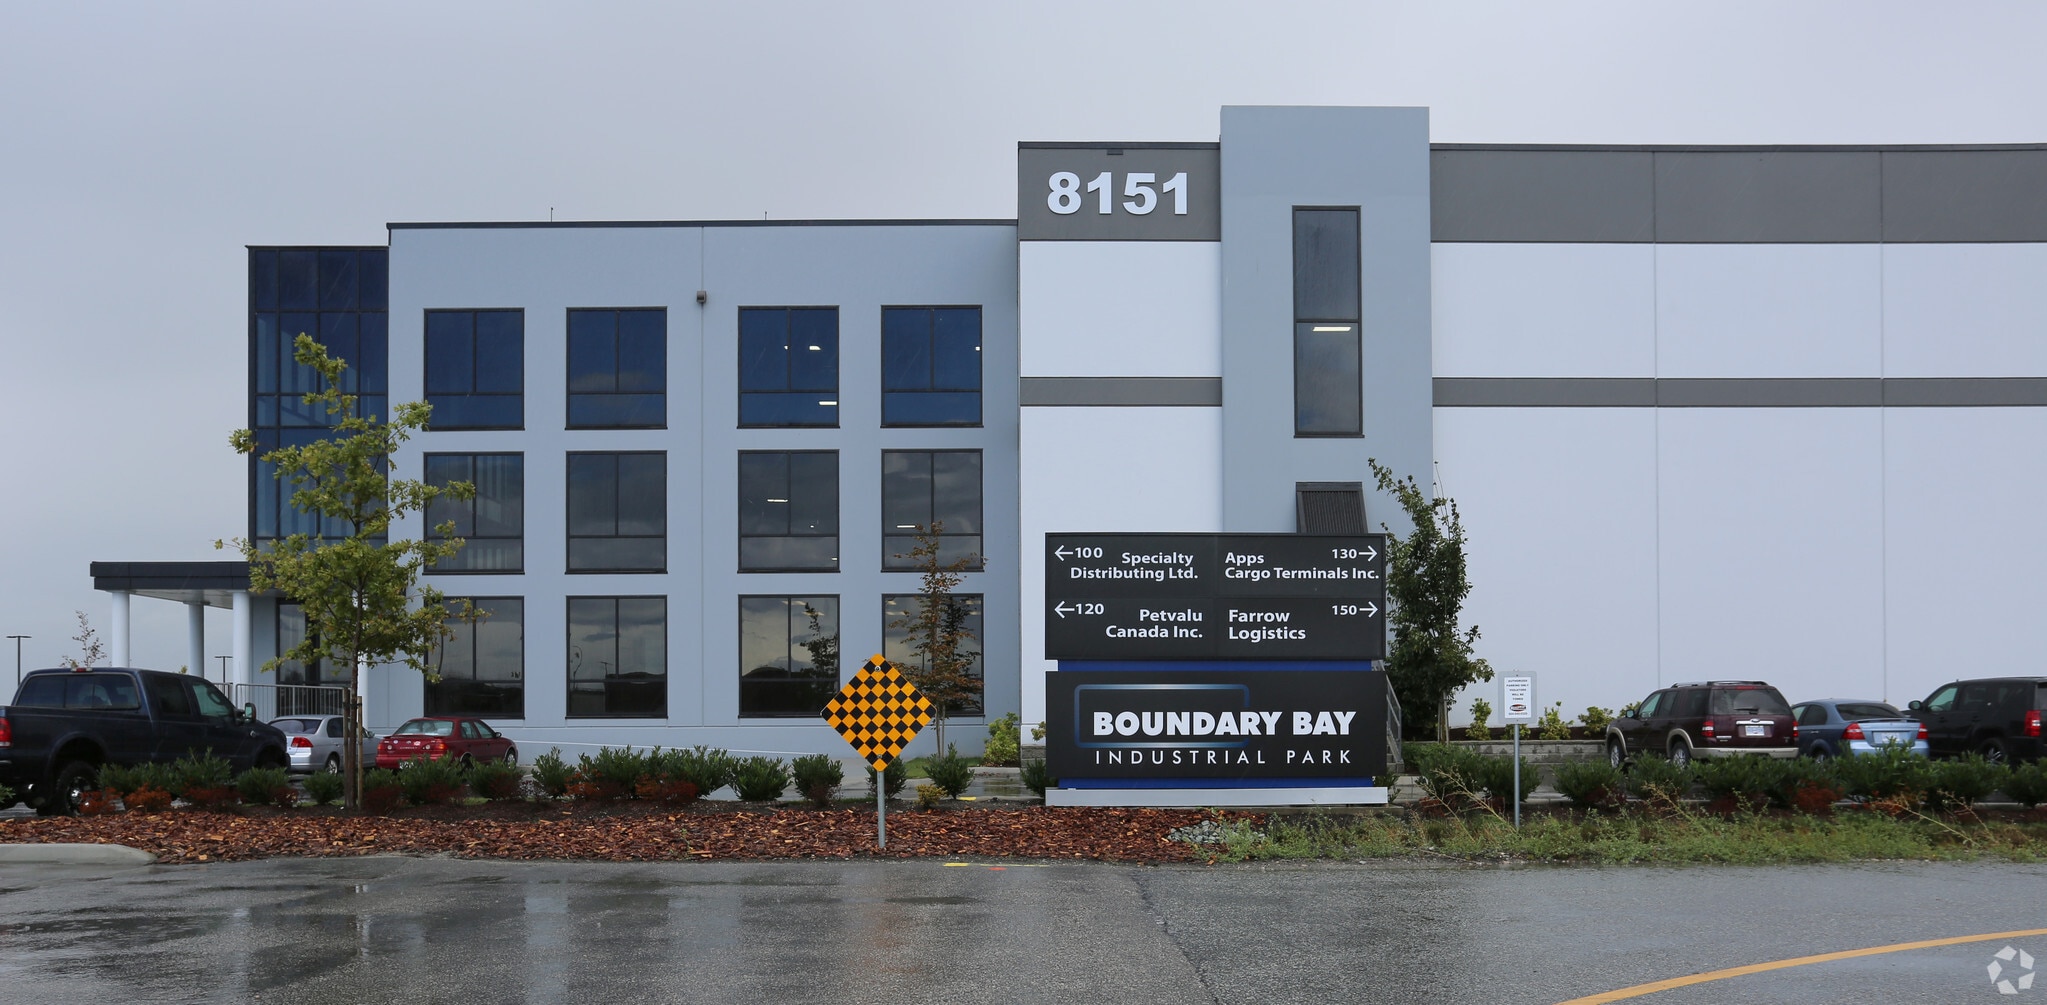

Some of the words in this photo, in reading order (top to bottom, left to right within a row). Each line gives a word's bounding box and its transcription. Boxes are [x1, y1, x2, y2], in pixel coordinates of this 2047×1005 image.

[1047, 171, 1188, 215] 8151
[1075, 547, 1103, 559] 100
[1121, 551, 1194, 567] Specialty
[1224, 552, 1265, 566] Apps
[1331, 548, 1357, 559] 130
[1070, 567, 1165, 582] Distributing
[1168, 567, 1199, 579] Ltd.
[1224, 567, 1271, 582] Cargo
[1273, 567, 1349, 579] Terminals
[1352, 567, 1380, 579] Inc.
[1075, 603, 1105, 615] 120
[1139, 608, 1203, 622] Petvalu
[1229, 609, 1291, 623] Farrow
[1331, 605, 1357, 616] 150
[1105, 624, 1169, 638] Canada
[1173, 625, 1203, 638] Inc.
[1229, 626, 1306, 643] Logistics
[1093, 711, 1283, 736] BOUNDARY
[1292, 711, 1357, 736] BAY
[1096, 750, 1266, 765] INDUSTRIAL
[1286, 749, 1351, 764] PARK
